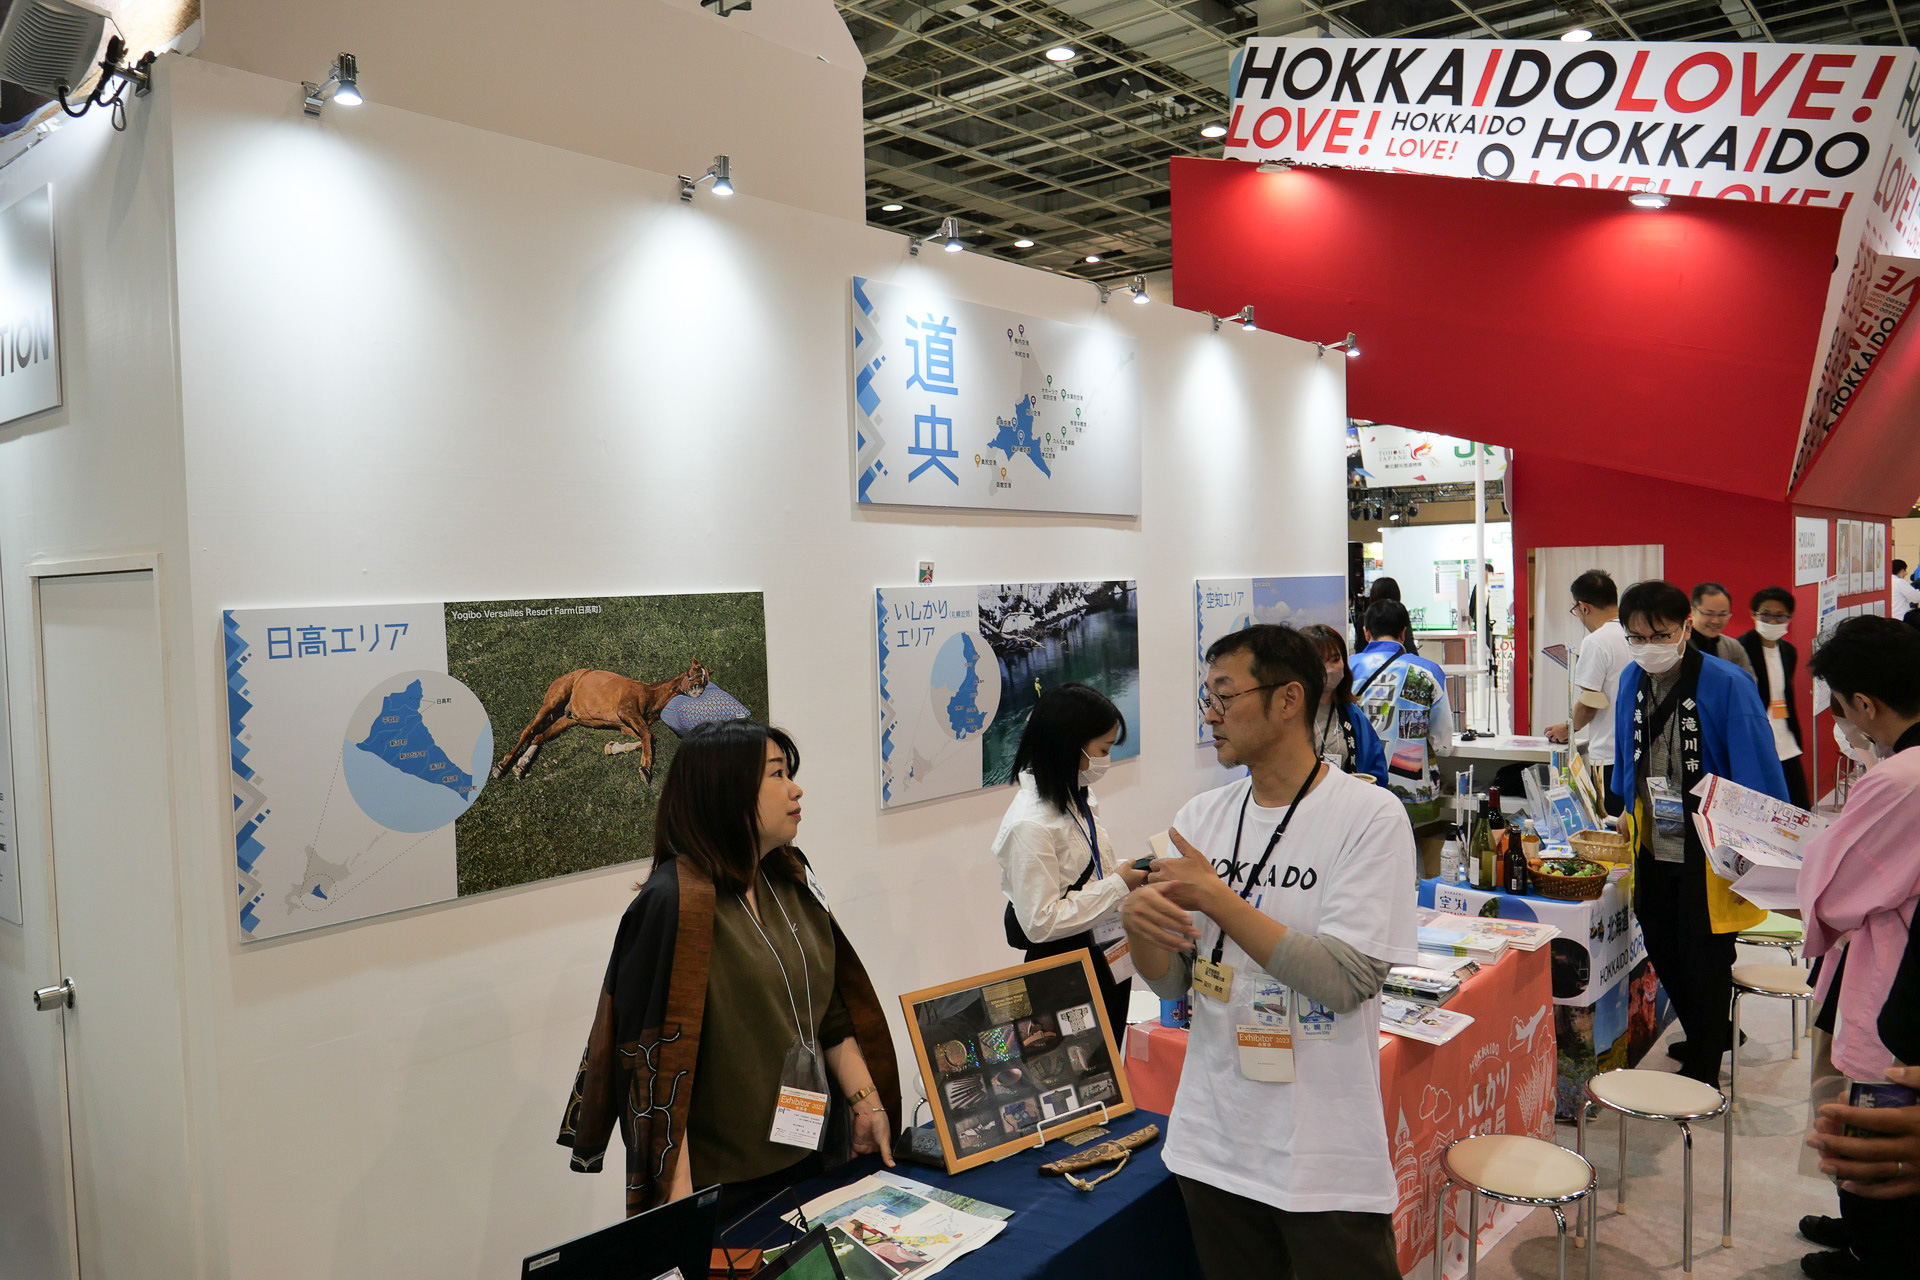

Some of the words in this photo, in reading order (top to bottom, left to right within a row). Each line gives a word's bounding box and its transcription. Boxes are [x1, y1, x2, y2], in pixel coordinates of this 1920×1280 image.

[1225, 105, 1381, 155] LOVE!
[1391, 111, 1526, 136] HOKKAIDO
[1386, 137, 1458, 160] LOVE!
[1531, 118, 1871, 178] HOKKAIDO
[905, 313, 959, 486] 道央
[894, 600, 949, 621] いしかり
[1206, 591, 1245, 608] 空知エリア
[451, 610, 482, 621] Yogibo
[484, 609, 524, 619] Versailles
[525, 607, 553, 617] Resort
[267, 622, 409, 660] 日高エリア
[897, 627, 935, 647] エリア
[1681, 717, 1700, 773] 滝川市
[1239, 1033, 1273, 1042] Exhibitor
[1275, 1036, 1290, 1044] 2023
[780, 1095, 811, 1108] Exhibitor
